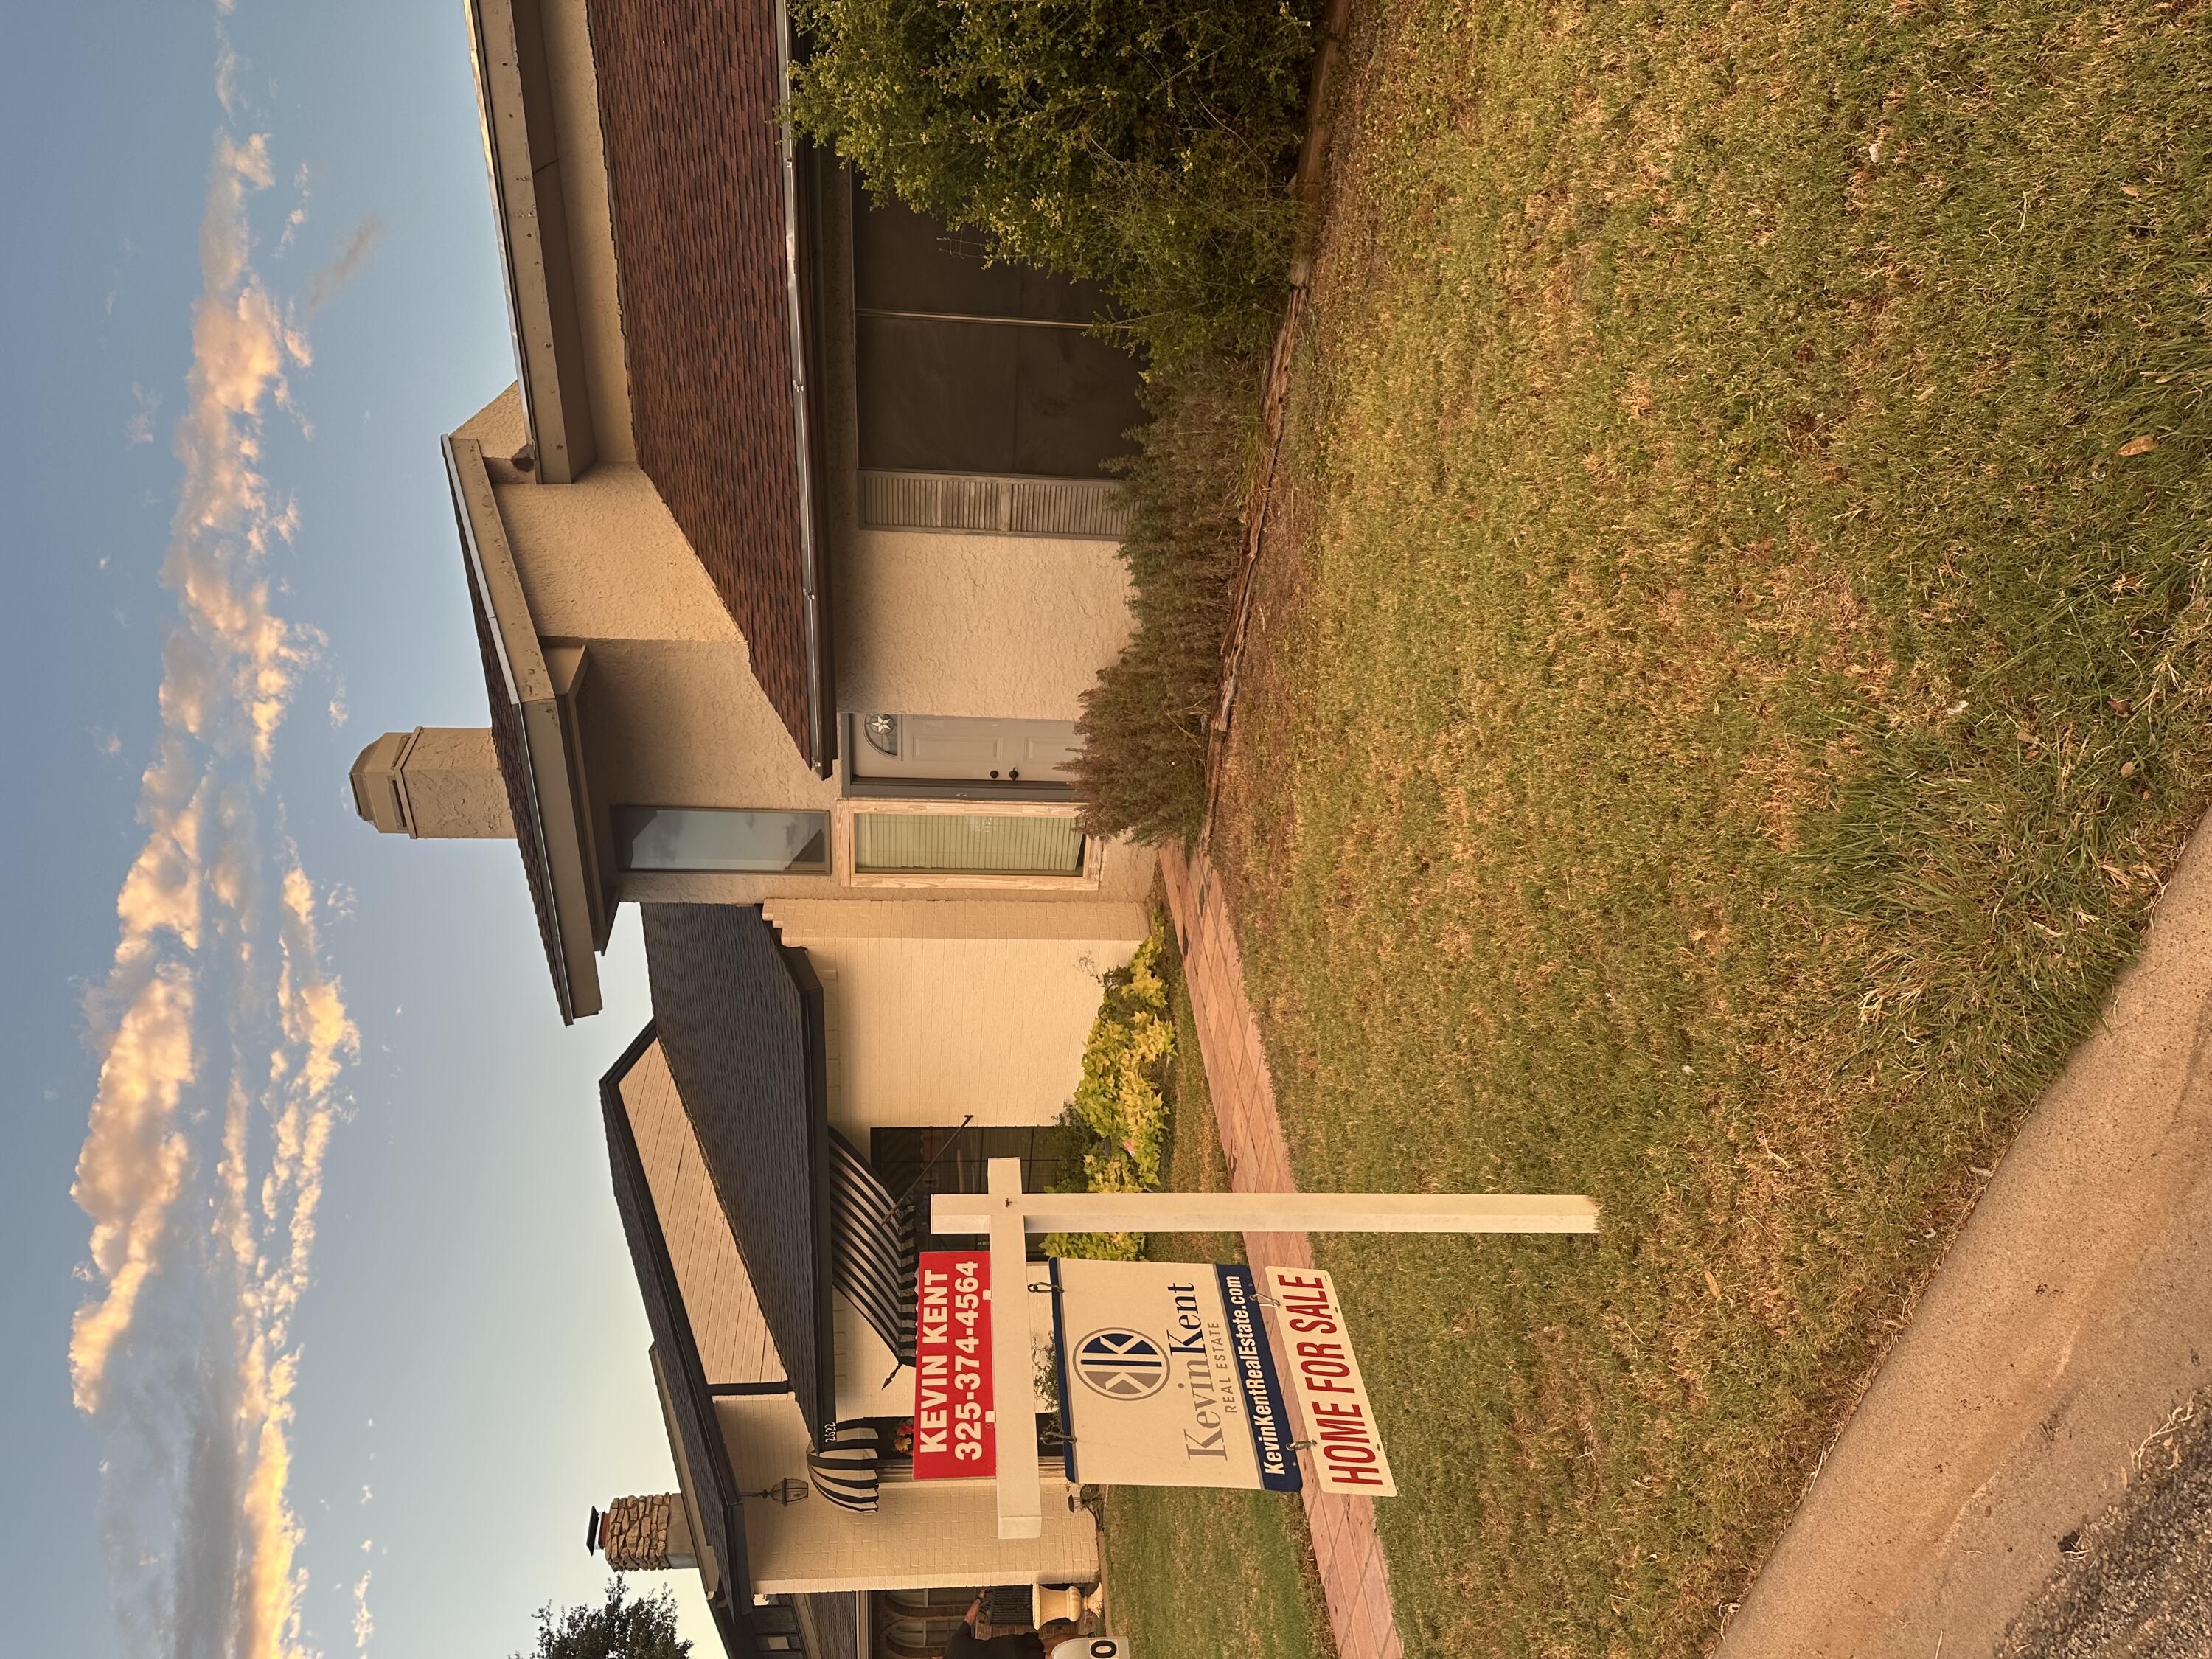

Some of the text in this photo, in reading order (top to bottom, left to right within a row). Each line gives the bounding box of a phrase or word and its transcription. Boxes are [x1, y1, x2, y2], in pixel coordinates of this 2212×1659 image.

[824, 1422, 836, 1442] 2622
[920, 1270, 948, 1453] KEVIN KENT
[955, 1261, 982, 1461] 325-374-4564
[1208, 1322, 1237, 1413] REAL ESTATE
[1225, 1276, 1285, 1475] KevinKentRealEstate.com
[1277, 1275, 1382, 1485] HOME FOR SALE
